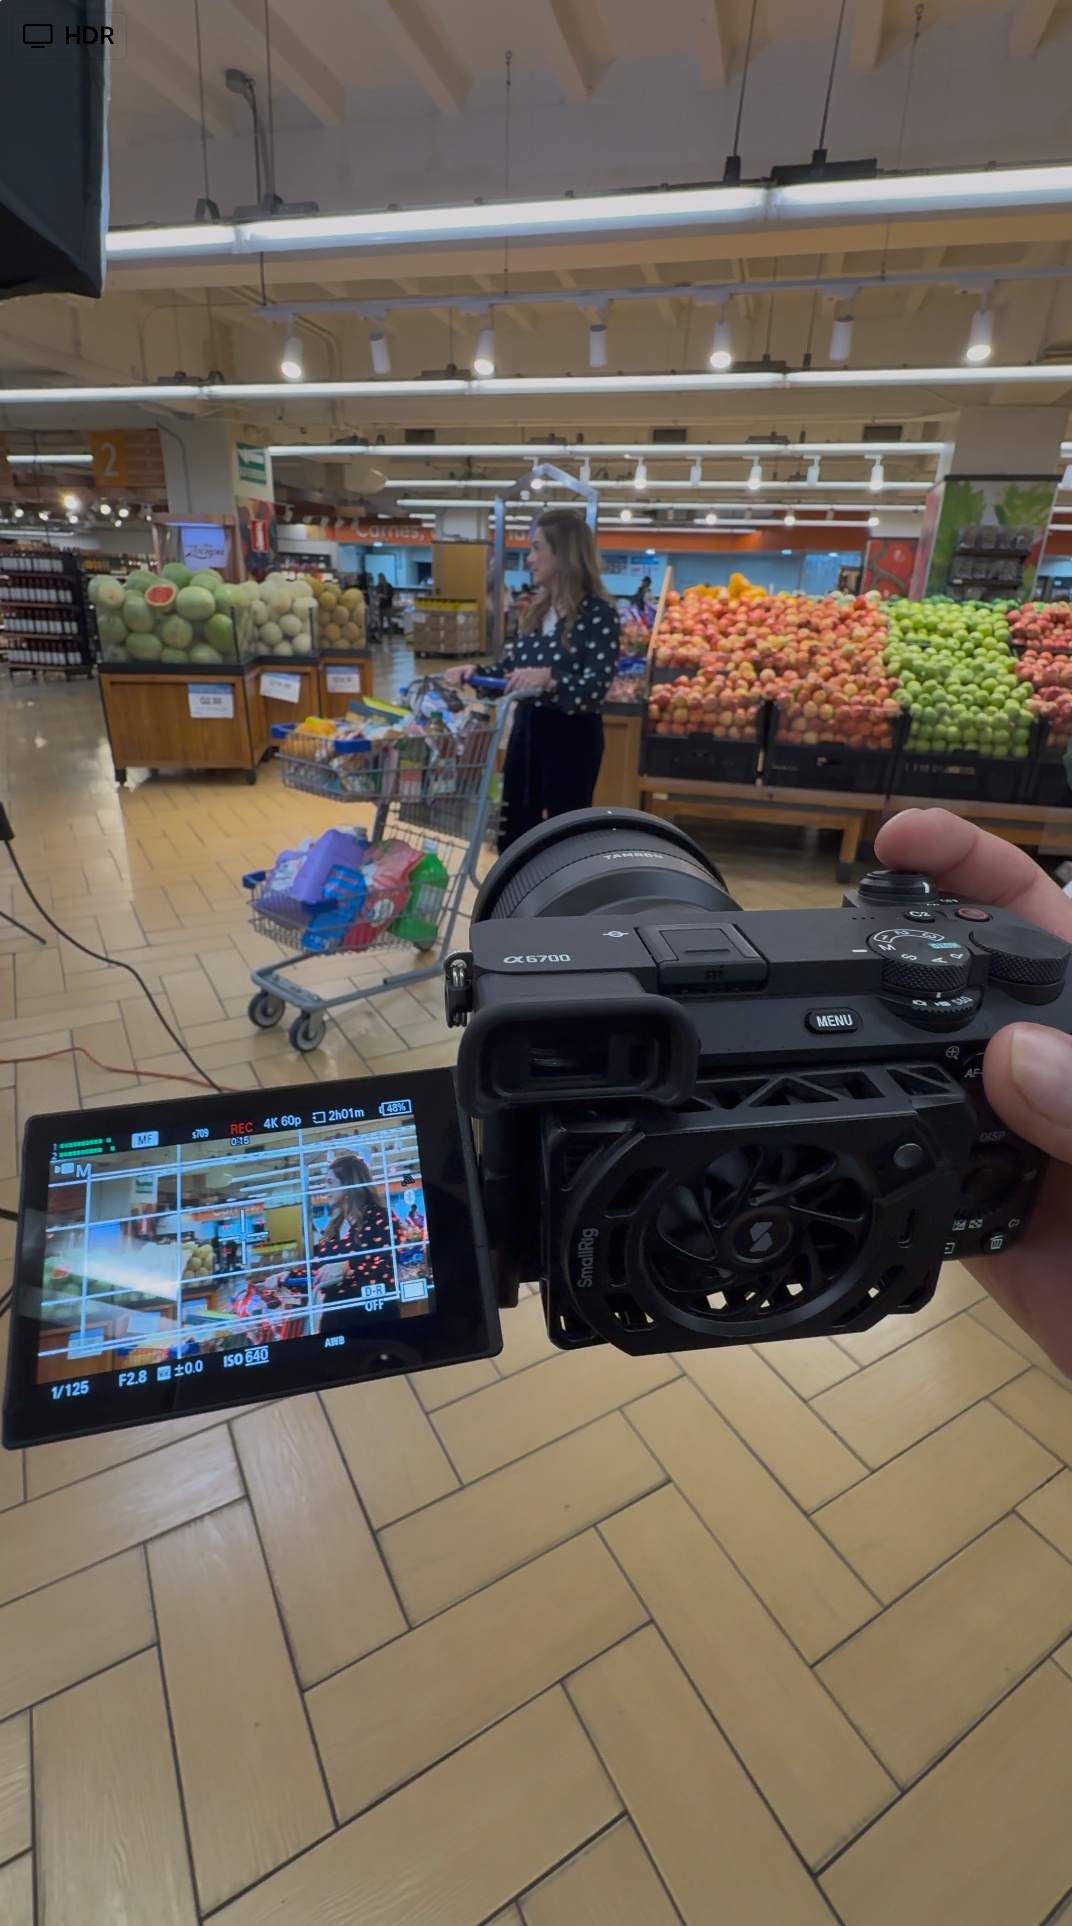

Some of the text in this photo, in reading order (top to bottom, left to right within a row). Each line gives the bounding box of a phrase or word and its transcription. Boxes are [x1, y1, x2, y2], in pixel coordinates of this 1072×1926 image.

[102, 442, 119, 477] 2
[603, 851, 663, 861] TAMRON
[909, 910, 931, 918] C2
[878, 943, 896, 951] M
[901, 953, 917, 961] S
[816, 1014, 854, 1029] MENU
[387, 1102, 406, 1113] 48%
[328, 1108, 365, 1122] 2h01m
[230, 1121, 254, 1135] REC
[263, 1115, 302, 1130] 4K 60p
[191, 1127, 210, 1140] s709
[980, 1130, 1006, 1142] DISP
[75, 1163, 92, 1178] M
[577, 1227, 599, 1288] SmallRig
[364, 1299, 385, 1312] OFF
[324, 1335, 346, 1348] AWB
[223, 1347, 269, 1368] ISO 640
[118, 1369, 148, 1387] F2.8
[51, 1380, 90, 1400] 1/125
